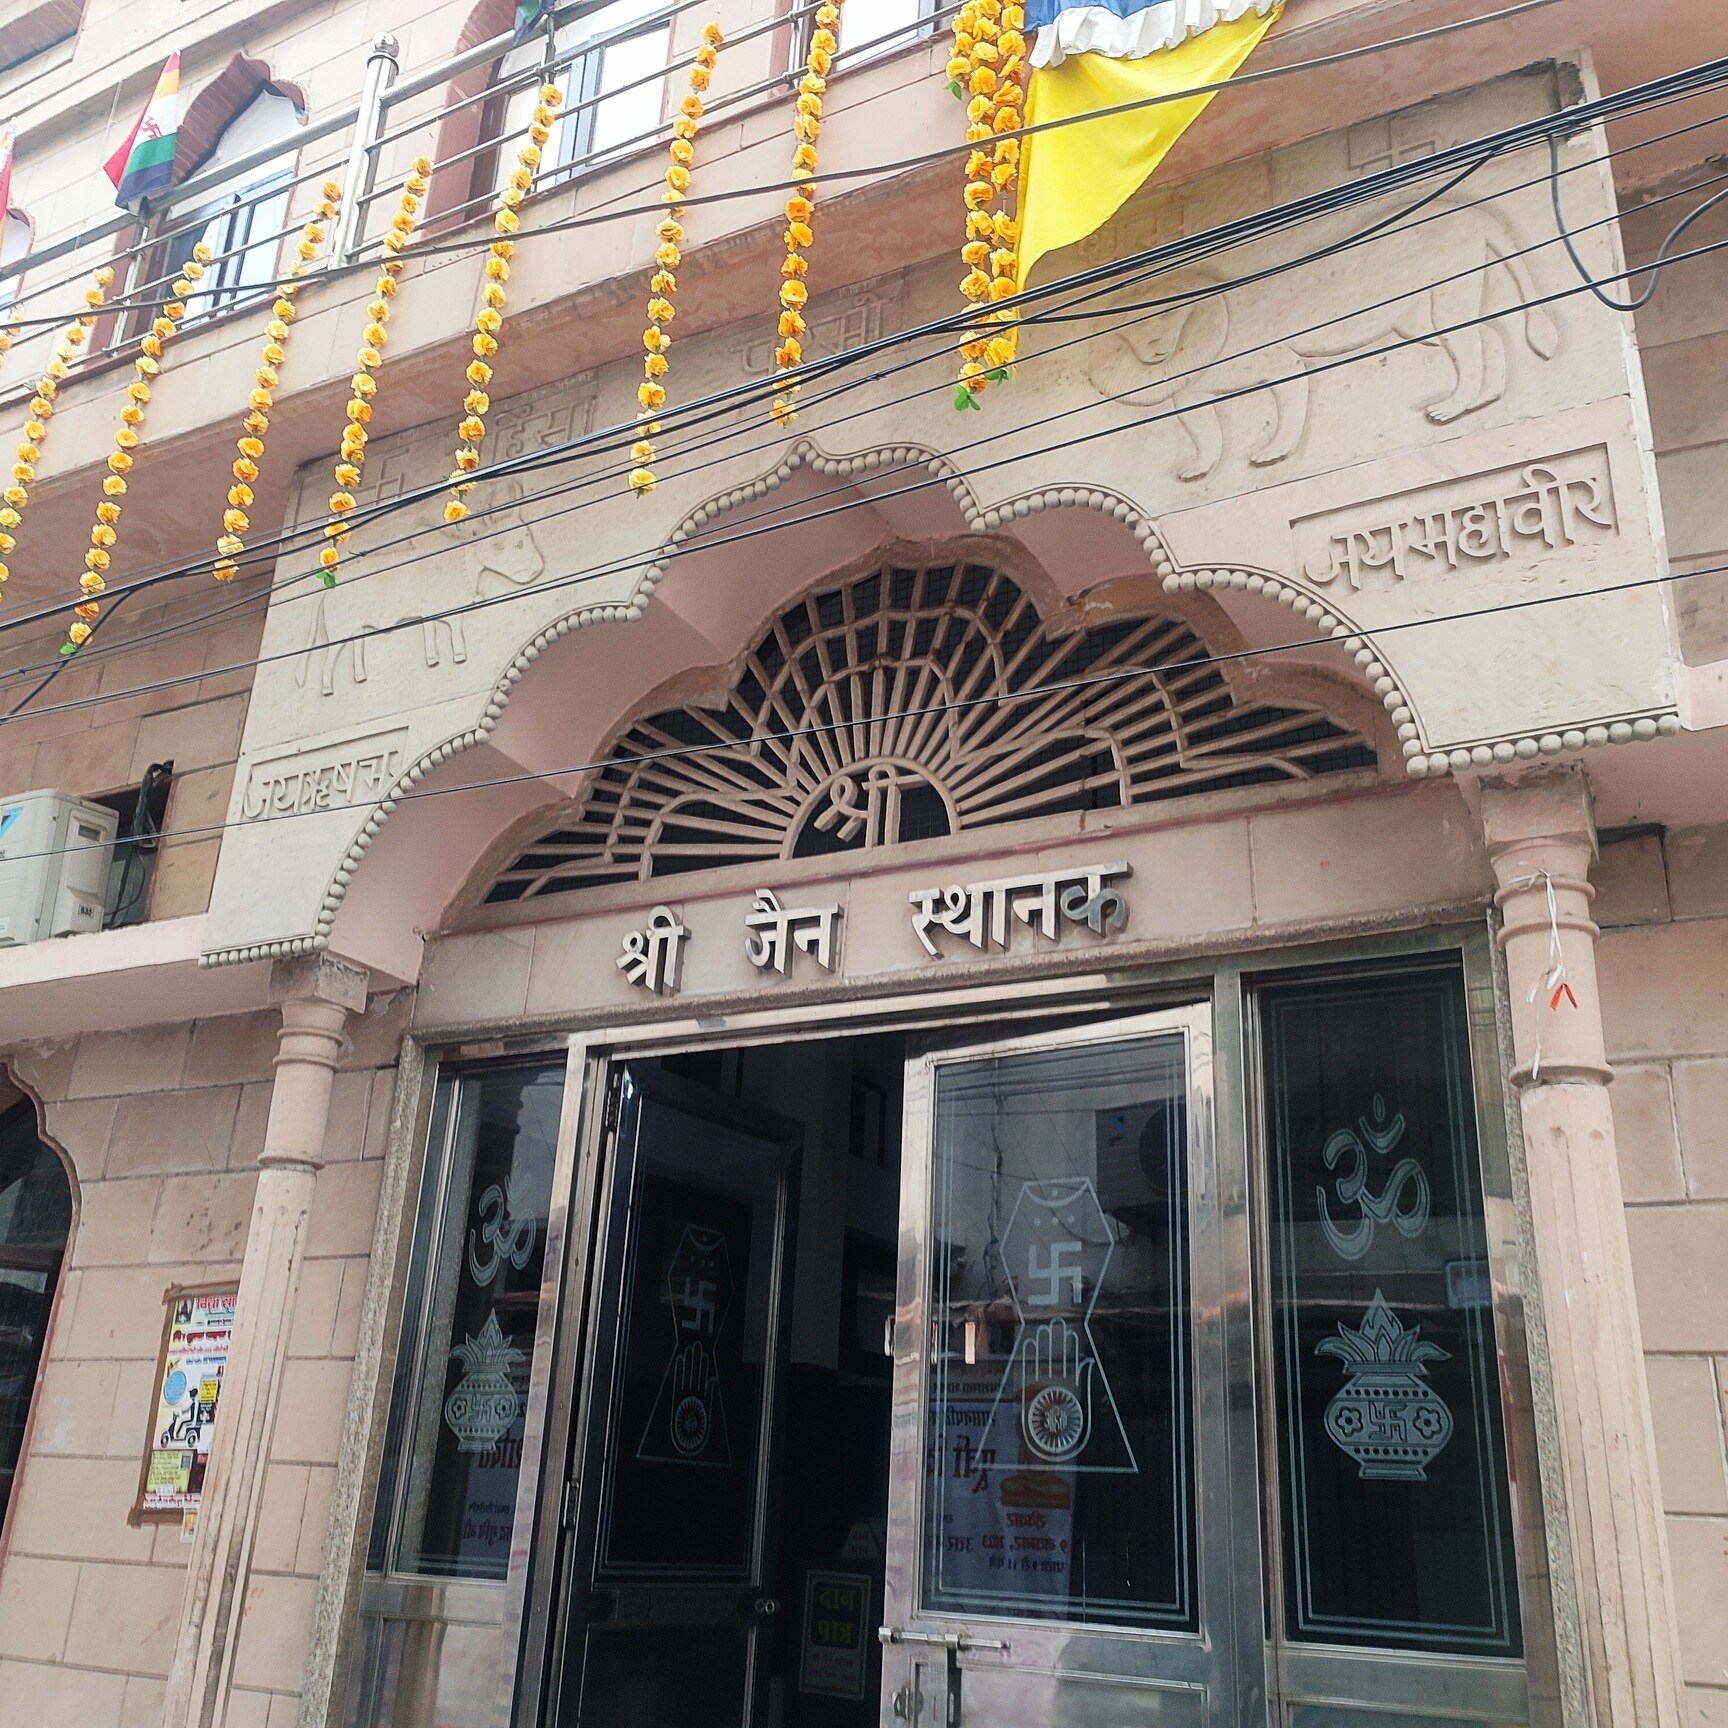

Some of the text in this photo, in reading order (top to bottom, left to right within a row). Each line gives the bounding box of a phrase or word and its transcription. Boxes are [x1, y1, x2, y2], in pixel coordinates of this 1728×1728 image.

[814, 762, 930, 848] श्री
[616, 860, 1134, 996] श्री जैन स्थानक
